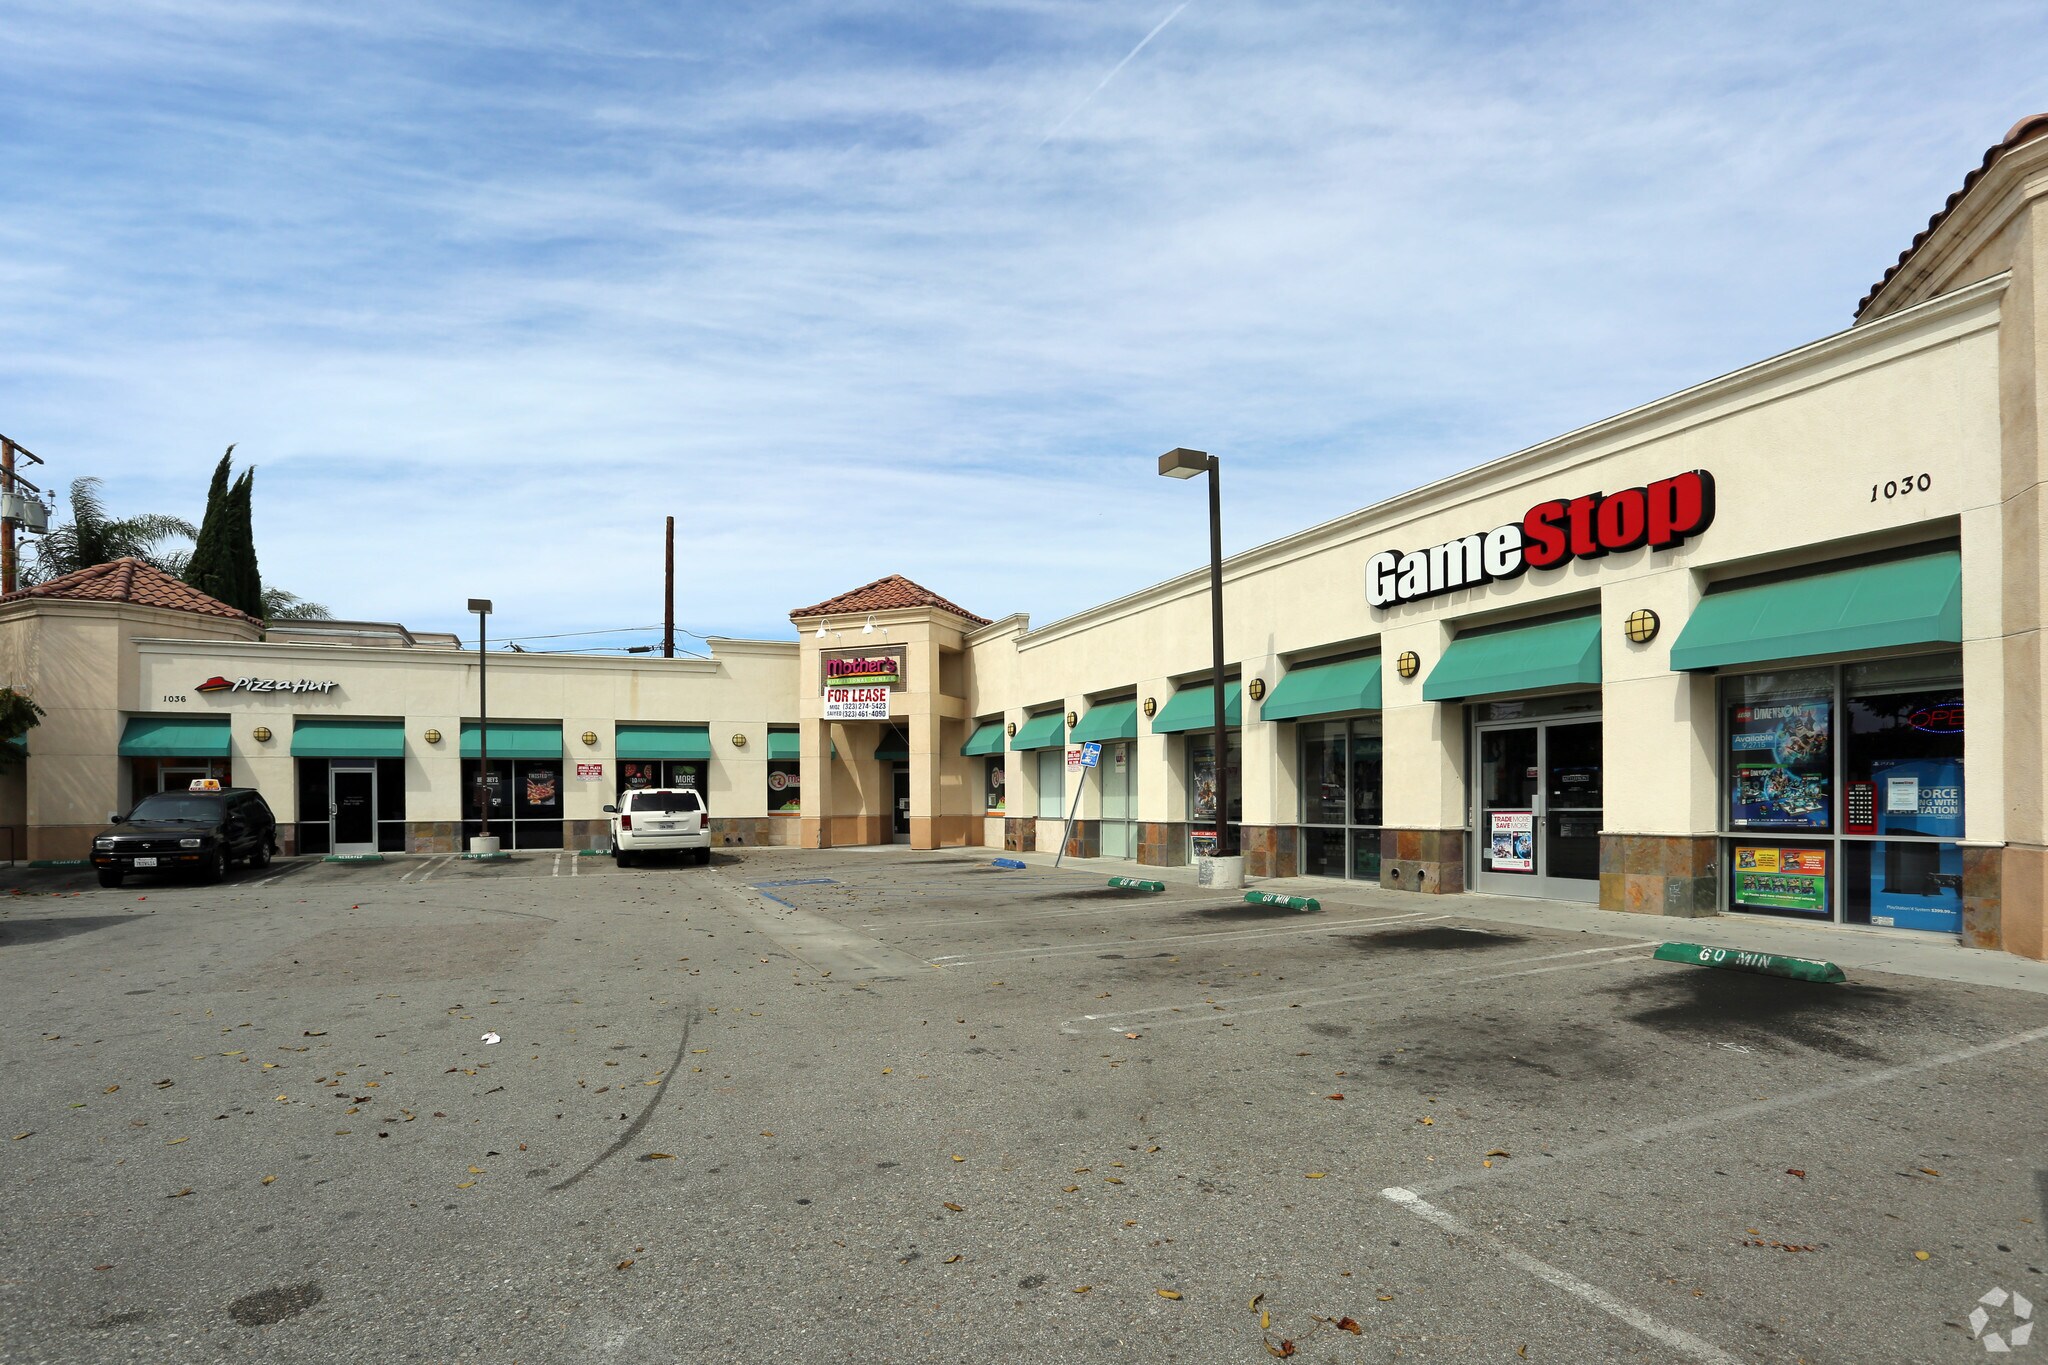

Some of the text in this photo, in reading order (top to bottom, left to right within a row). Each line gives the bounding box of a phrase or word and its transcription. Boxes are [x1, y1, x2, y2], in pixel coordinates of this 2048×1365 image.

[1870, 473, 1932, 502] 1030
[1365, 469, 1715, 609] GameStop
[826, 656, 897, 676] Mother's
[232, 677, 338, 694] Pizza Hut
[163, 695, 187, 703] 1036
[827, 688, 886, 702] FOR LEASE
[1754, 705, 1802, 720] DIMENSIONS
[1735, 734, 1774, 743] Available
[675, 775, 695, 783] MORE
[1276, 894, 1291, 904] MIN
[1735, 952, 1772, 968] MIN
